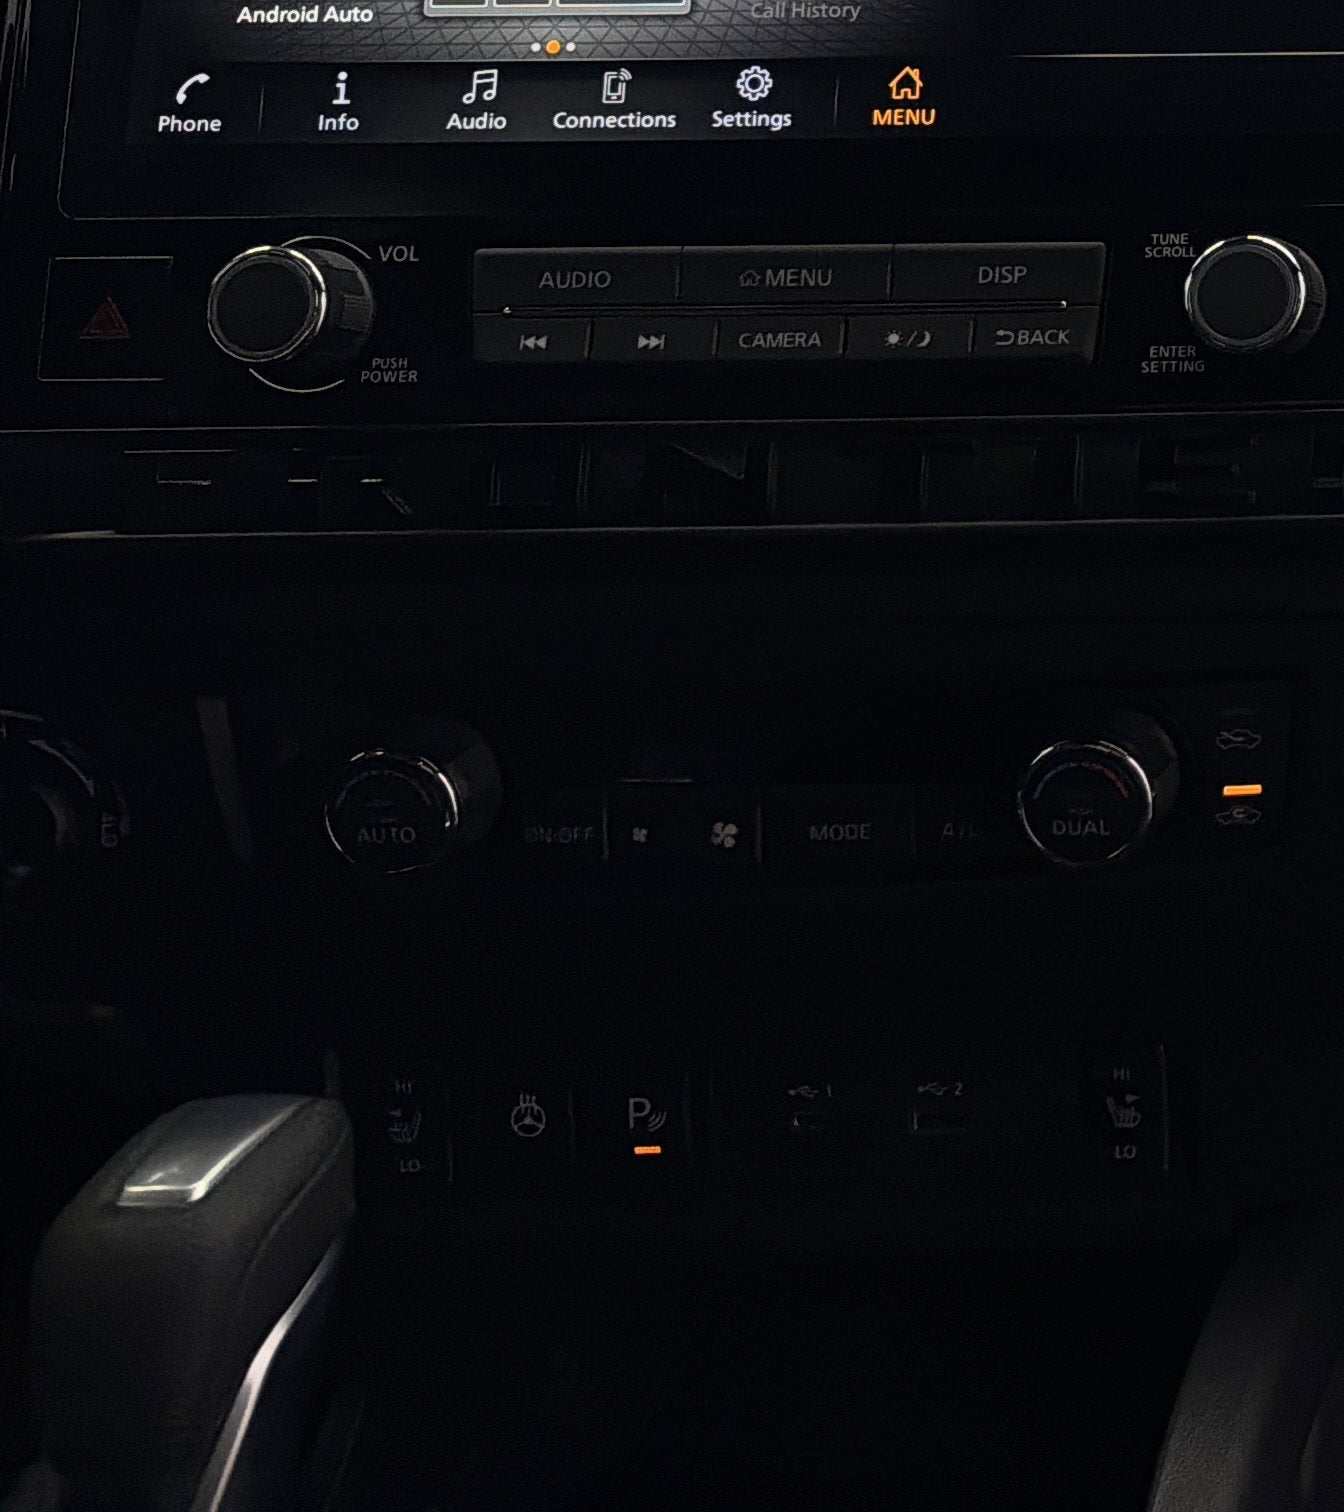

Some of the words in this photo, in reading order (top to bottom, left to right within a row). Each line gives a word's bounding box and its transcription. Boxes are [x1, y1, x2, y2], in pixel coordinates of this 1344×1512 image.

[237, 5, 319, 23] Android
[323, 6, 373, 22] Auto
[750, 1, 786, 20] Call
[791, 0, 861, 22] History
[158, 115, 221, 132] Phone
[319, 113, 359, 130] Info
[446, 112, 507, 129] Audio
[553, 112, 676, 128] Connections
[712, 111, 791, 131] Settings
[873, 109, 935, 125] MENU
[1152, 233, 1188, 245] TUNE
[379, 246, 419, 262] VOL
[1145, 246, 1195, 258] SCROLL
[539, 271, 611, 288] AUDIO
[766, 269, 832, 286] MENU
[978, 266, 1027, 283] DISP
[739, 332, 821, 348] CAMERA
[1018, 330, 1069, 345] BACK
[1150, 346, 1195, 358] ENTER
[372, 357, 407, 369] PUSH
[1141, 361, 1204, 373] SETTING
[361, 370, 417, 383] POWER
[358, 826, 416, 843] AUTO
[810, 823, 870, 841] MODE
[1053, 819, 1110, 836] DUAL
[1114, 1144, 1138, 1160] LO
